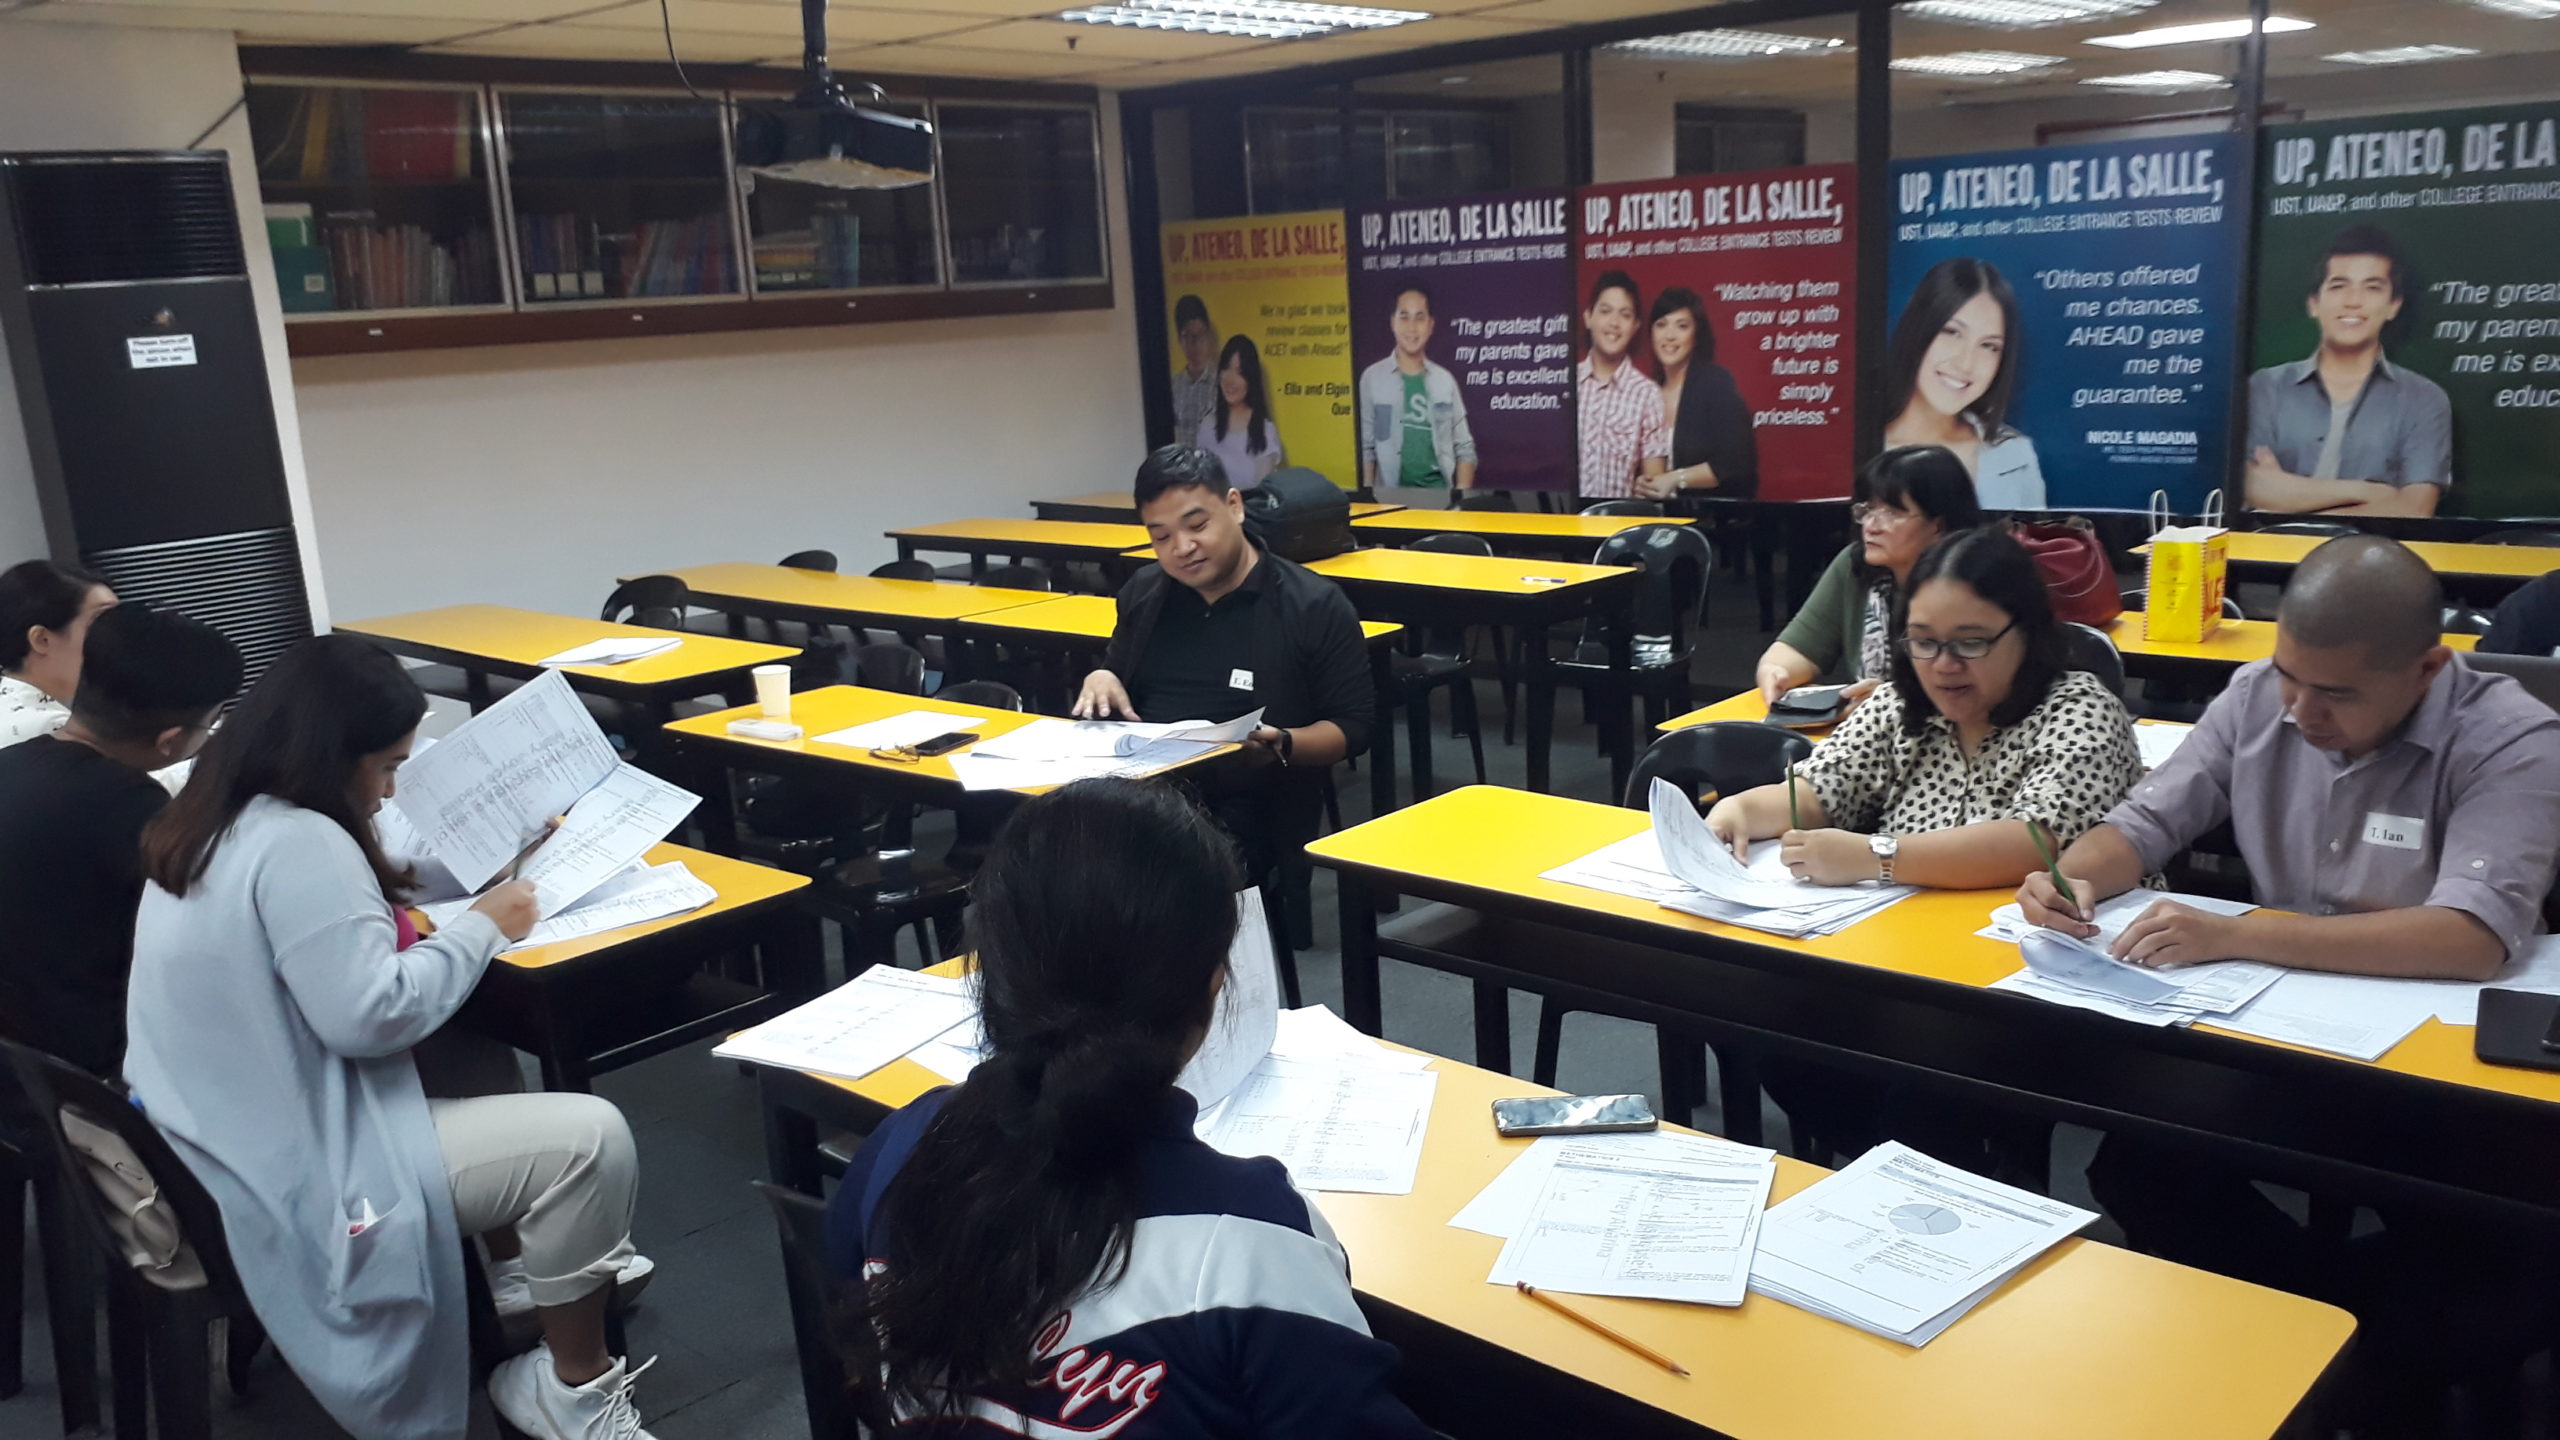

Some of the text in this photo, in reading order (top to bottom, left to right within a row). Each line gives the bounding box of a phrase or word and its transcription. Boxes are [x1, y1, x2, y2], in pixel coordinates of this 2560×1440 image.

[2273, 119, 2556, 188] UP, ATENEO, DE LA
[1900, 150, 2224, 217] UP, ATENEO, DE LA SALLE,
[1584, 177, 1843, 238] UP, ATENEO, DE LA SALLE,
[2349, 192, 2376, 209] and
[2380, 190, 2416, 208] other
[2419, 186, 2485, 207] COLLEGE
[1361, 198, 1567, 250] UP, ATENEO, DE LA SALLE
[1961, 221, 1982, 237] and
[1984, 219, 2012, 235] other
[2015, 215, 2068, 234] COLLEGE
[2070, 211, 2132, 231] ENTRANCE
[2134, 209, 2172, 228] TESTS
[2175, 205, 2224, 225] REVIEW
[1192, 230, 1247, 261] ATENEO,
[1251, 228, 1268, 258] DE
[1273, 226, 1290, 257] LA
[1294, 223, 1346, 261] SALLE,
[2034, 263, 2202, 290] "Others offered
[1796, 279, 1840, 298] them
[2428, 280, 2490, 304] "The
[1734, 305, 1840, 330] grow up with
[2064, 296, 2203, 317] me chances.
[1484, 315, 1542, 339] greatest
[1543, 313, 1569, 338] gift
[2065, 325, 2204, 350] AHEAD gave
[2433, 320, 2477, 343] my
[1455, 342, 1569, 364] my parents gave
[1760, 331, 1840, 353] a brighter
[1771, 356, 1840, 375] future is
[2123, 354, 2203, 375] me the
[2451, 354, 2496, 373] me
[2499, 349, 2526, 373] is
[1466, 366, 1570, 386] me is excellent
[1305, 384, 1323, 395] and
[1779, 382, 1835, 404] simply
[2086, 430, 2198, 445] NICOLE MAGADIA
